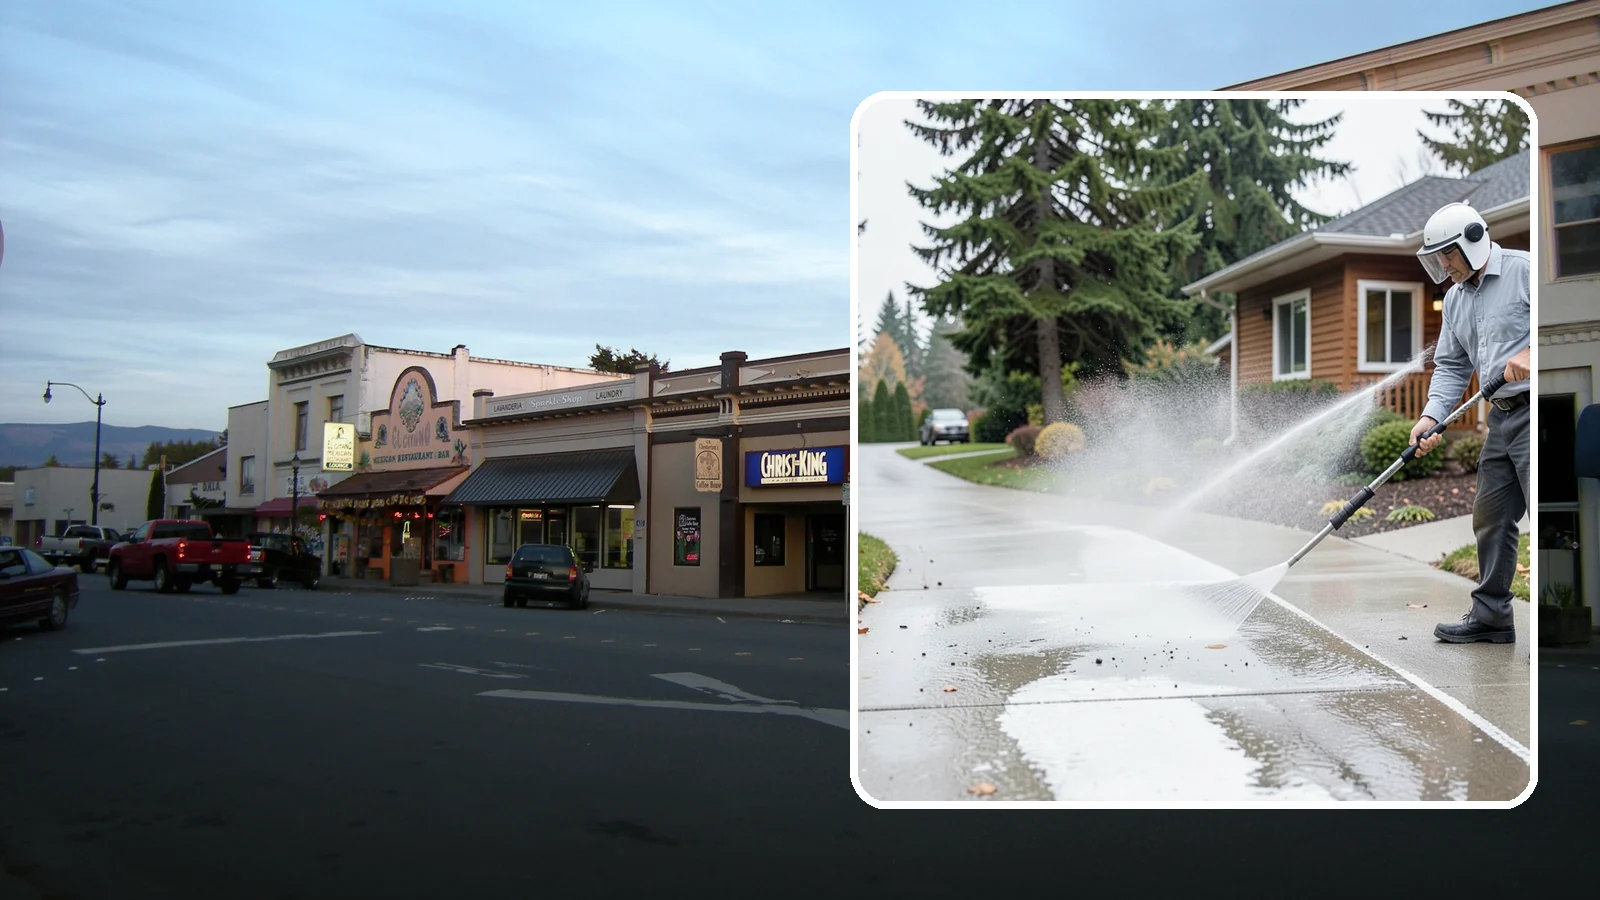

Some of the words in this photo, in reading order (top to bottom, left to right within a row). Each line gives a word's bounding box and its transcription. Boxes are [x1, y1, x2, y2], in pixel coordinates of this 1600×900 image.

[562, 394, 583, 405] Shop
[595, 389, 624, 400] LAUNDRY
[493, 402, 522, 413] LAVANDERIA
[373, 455, 396, 464] MEXICAN
[397, 451, 433, 462] RESTAURANT
[438, 450, 450, 459] BAR
[760, 452, 797, 478] CHRIST
[799, 450, 827, 477] KING
[696, 480, 709, 489] Coffee
[710, 480, 722, 489] House
